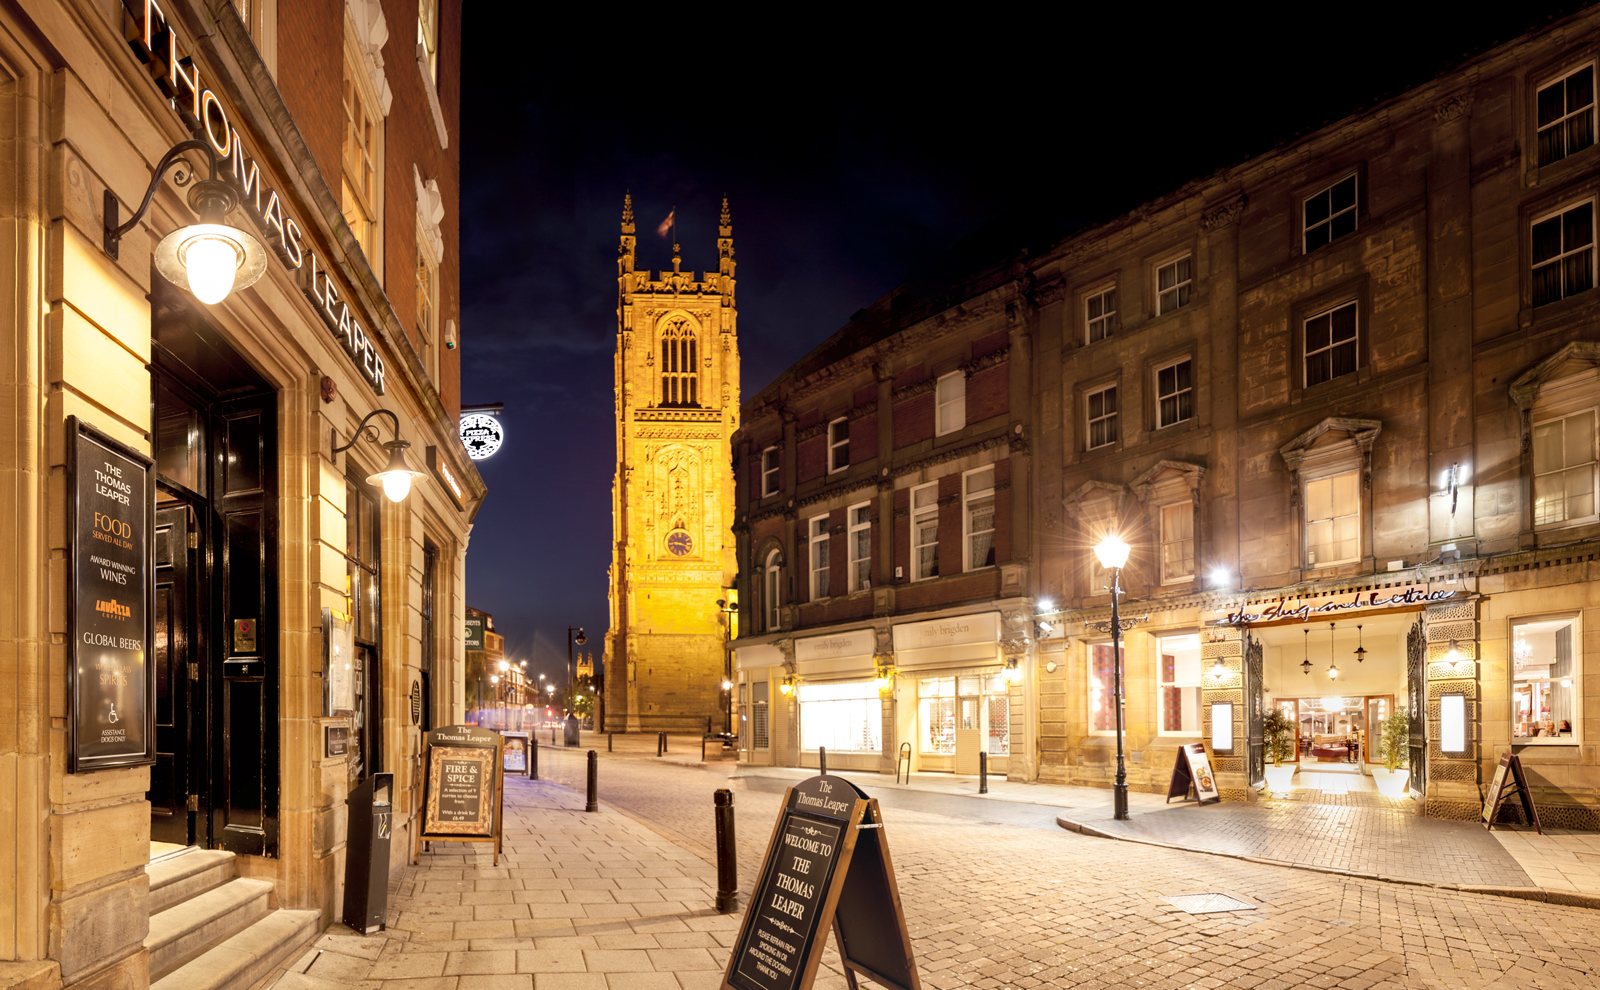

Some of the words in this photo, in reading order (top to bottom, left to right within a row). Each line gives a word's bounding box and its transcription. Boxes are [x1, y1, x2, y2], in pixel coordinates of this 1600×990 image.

[144, 0, 302, 268] THOMAS
[312, 252, 385, 393] LEAPER
[104, 462, 122, 478] THE
[94, 470, 132, 494] THOMAS
[96, 483, 130, 506] LEAPER
[94, 512, 132, 539] FOOD
[92, 530, 112, 543] SERVED
[112, 538, 122, 547] ALL
[122, 541, 133, 550] DAY
[90, 555, 111, 566] AWARD
[111, 560, 136, 575] WINNING
[100, 568, 126, 586] WINES
[96, 599, 131, 618] LAVAZZA
[1318, 593, 1361, 612] and
[1370, 588, 1456, 606] Lettuce
[102, 613, 125, 621] COFFEE
[940, 622, 970, 637] brigden
[83, 632, 118, 648] GLOBAL
[120, 638, 141, 651] BEERS
[814, 640, 829, 650] emily
[830, 638, 852, 649] brigden
[95, 663, 115, 672] WORLD
[116, 665, 132, 673] CLASS
[100, 674, 128, 687] SPIRITS
[436, 733, 465, 741] Thomas
[445, 765, 468, 773] FIRE
[470, 766, 478, 774] &
[447, 774, 476, 782] SPICE
[819, 780, 832, 794] The
[798, 792, 823, 808] Thomas
[823, 796, 849, 814] Leaper
[785, 833, 818, 854] WELCOME
[820, 843, 832, 857] TO
[792, 856, 812, 875] THE
[776, 872, 815, 900] THOMAS
[771, 894, 805, 920] LEAPER
[758, 929, 770, 941] PLEASE
[770, 935, 785, 949] REFRAIN
[785, 942, 796, 955] FROM
[759, 941, 777, 956] SMOKING
[781, 952, 788, 962] OR
[749, 946, 766, 961] AROUND
[772, 960, 792, 976] DOORWAY
[756, 961, 770, 976] THANK
[769, 970, 778, 980] YOU
